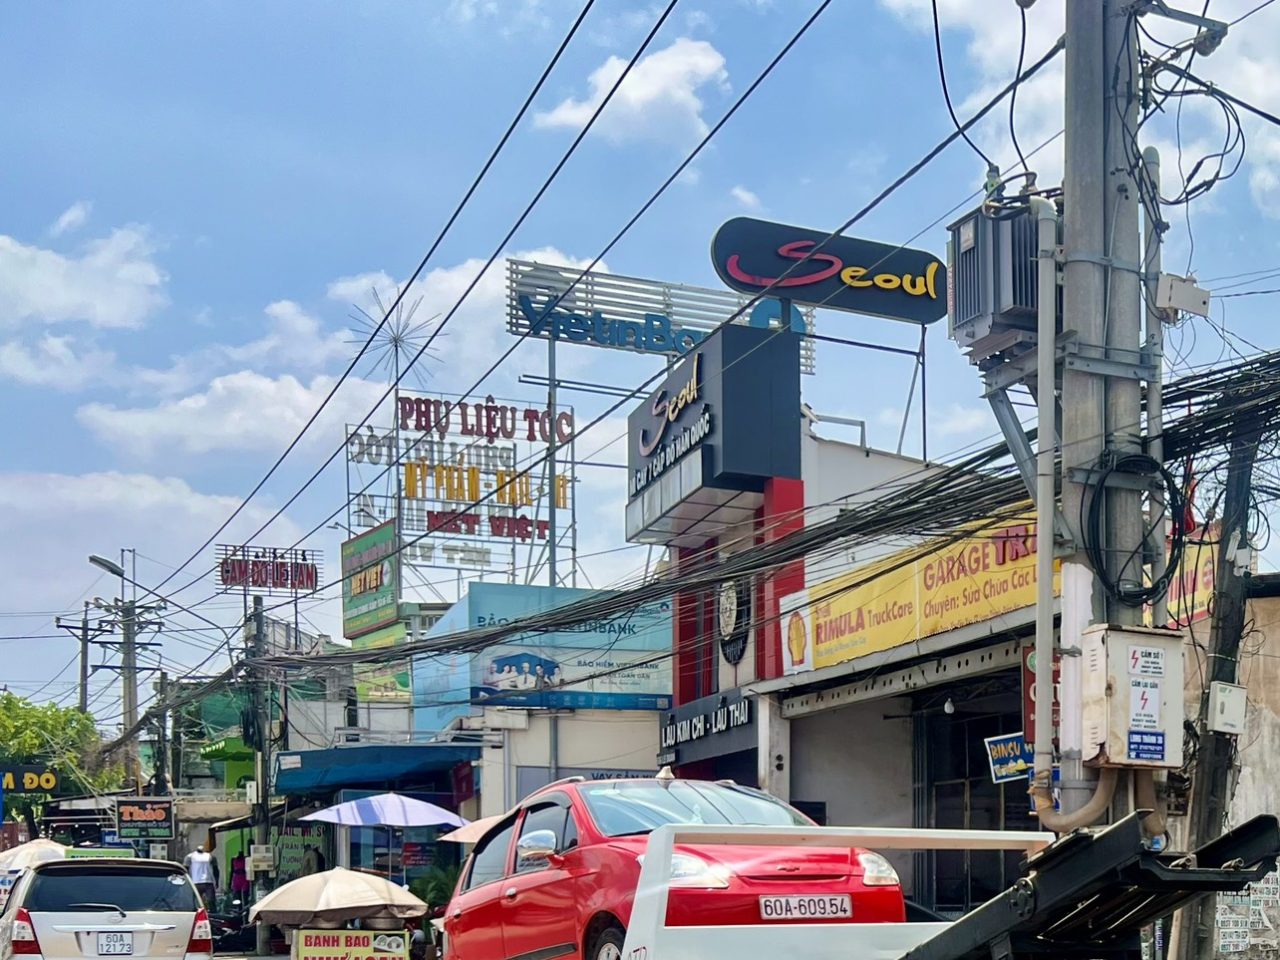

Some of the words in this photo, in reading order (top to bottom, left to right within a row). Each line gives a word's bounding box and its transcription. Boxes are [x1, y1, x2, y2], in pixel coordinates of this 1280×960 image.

[726, 240, 940, 300] Seoul
[639, 353, 703, 457] Seoul
[397, 397, 451, 441] PHỤ
[459, 393, 518, 445] LIỆU
[923, 541, 990, 592] GARAGE
[923, 594, 960, 619] Chuyên:
[815, 606, 866, 646] RIMULA
[867, 601, 914, 629] TruckCare
[676, 719, 690, 743] KIM
[692, 714, 704, 740] CHI
[990, 742, 1021, 761] BINSU
[119, 803, 166, 821] Thảo
[764, 898, 849, 917] 60A-609.54
[105, 934, 125, 943] 60A
[344, 935, 370, 947] BAO
